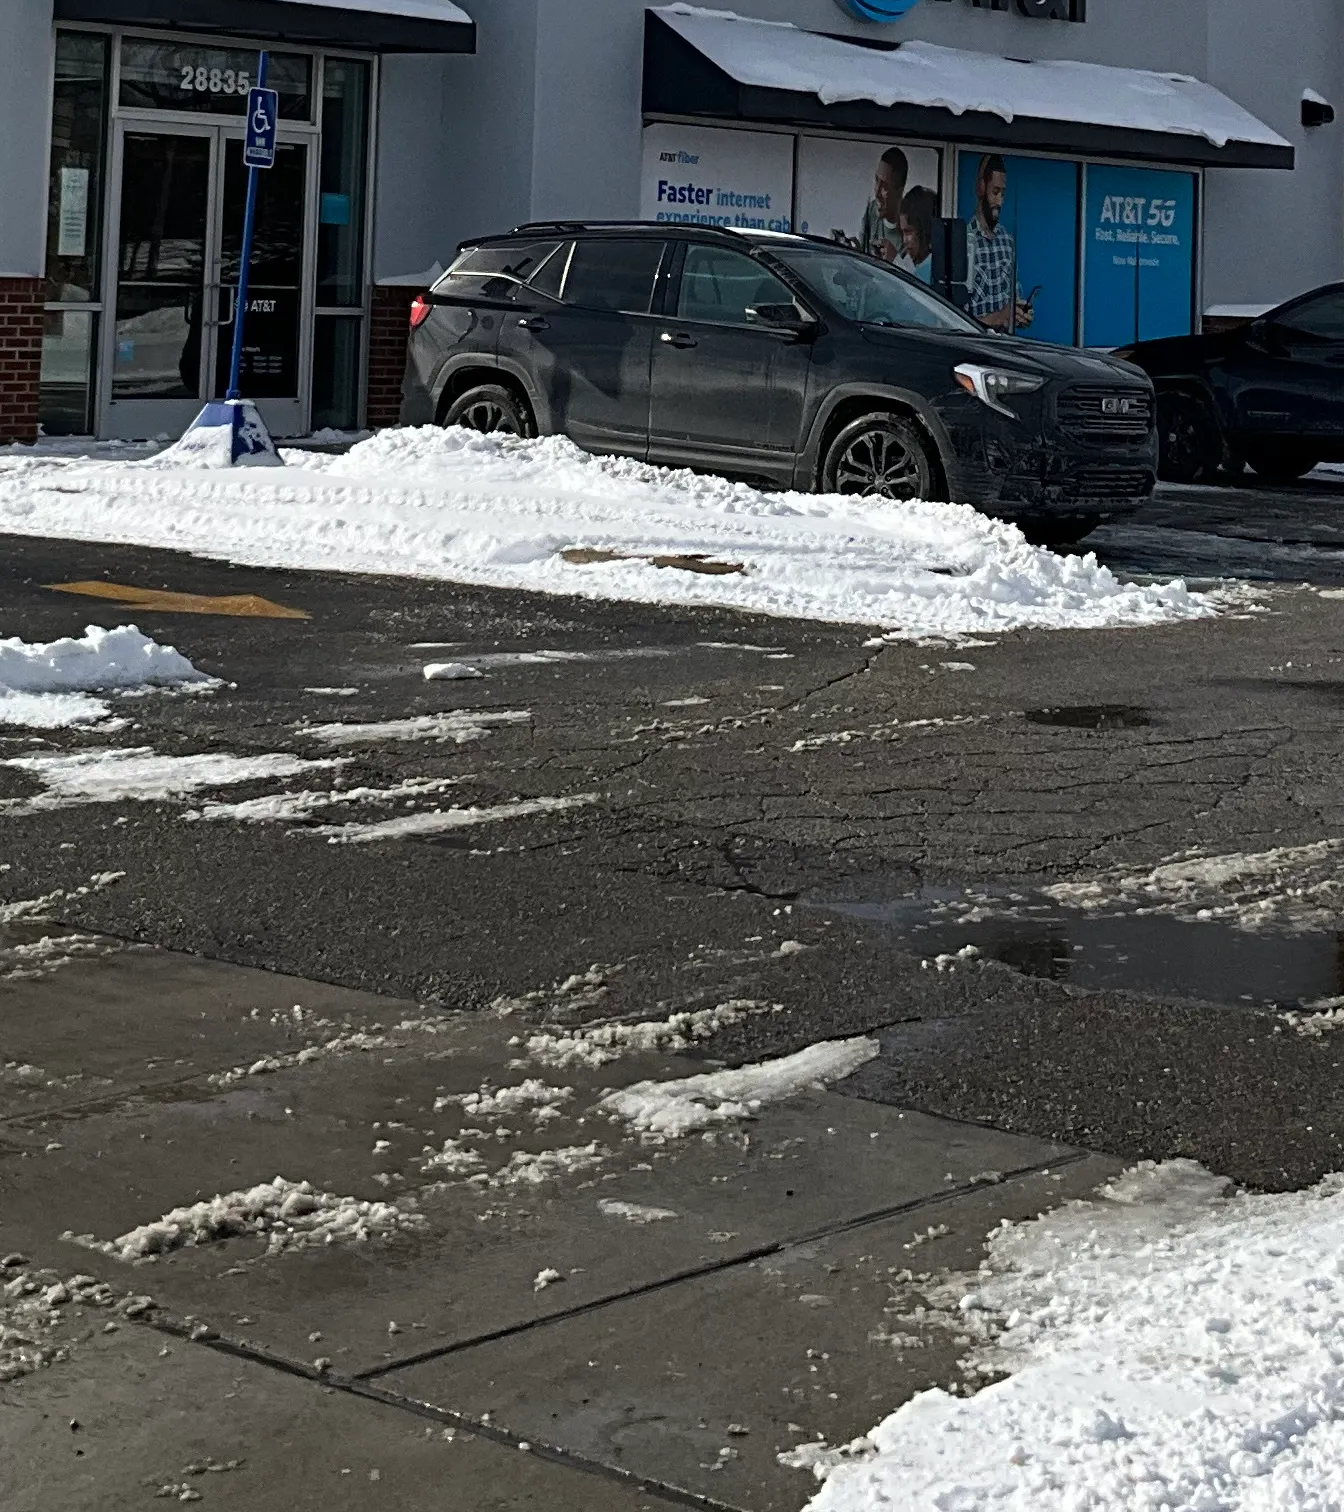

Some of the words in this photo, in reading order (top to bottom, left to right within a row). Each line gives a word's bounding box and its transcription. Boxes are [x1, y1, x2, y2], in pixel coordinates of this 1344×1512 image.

[179, 65, 250, 95] 28835
[657, 180, 713, 206] Faster
[716, 188, 771, 210] internet
[734, 213, 765, 230] than
[1100, 195, 1146, 225] AT&T
[1146, 199, 1176, 227] 5G
[251, 299, 276, 312] AT&T
